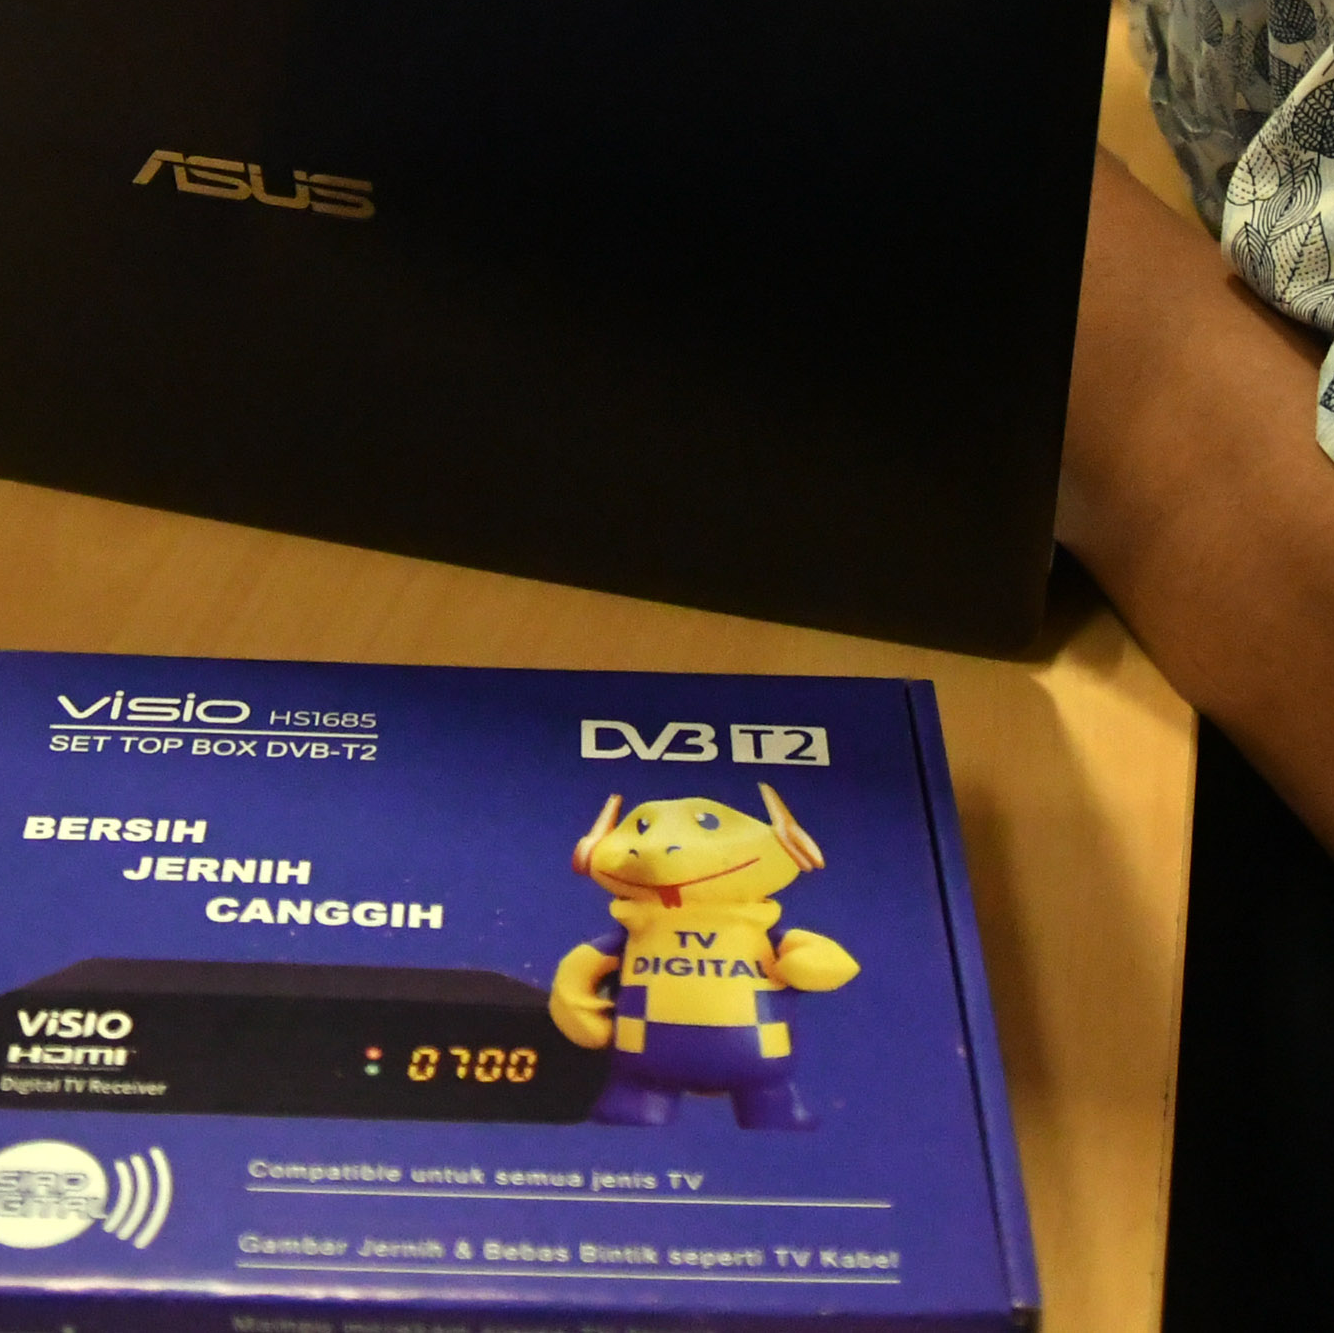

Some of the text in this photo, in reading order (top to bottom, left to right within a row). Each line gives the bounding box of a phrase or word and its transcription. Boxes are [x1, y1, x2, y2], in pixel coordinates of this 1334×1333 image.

[132, 149, 375, 218] ASUS
[269, 710, 377, 729] HS1685
[49, 735, 378, 761] SET TOP BOX DVB-T2
[581, 720, 820, 763] DVB T2
[22, 815, 208, 843] BERSIH
[122, 856, 312, 884] JERNIH
[205, 896, 443, 929] CANGGIH
[674, 931, 717, 949] TV
[407, 1045, 538, 1082] 0700
[0, 1074, 167, 1096] Digital TV Receiver
[248, 1159, 704, 1192] Compatible untuk semua jenis TV
[357, 1238, 445, 1258] Jernih
[454, 1238, 473, 1260] &
[483, 1240, 571, 1263] Bebas
[668, 1248, 764, 1270] seperti
[774, 1248, 812, 1268] TV
[819, 1250, 900, 1269] Kabel
